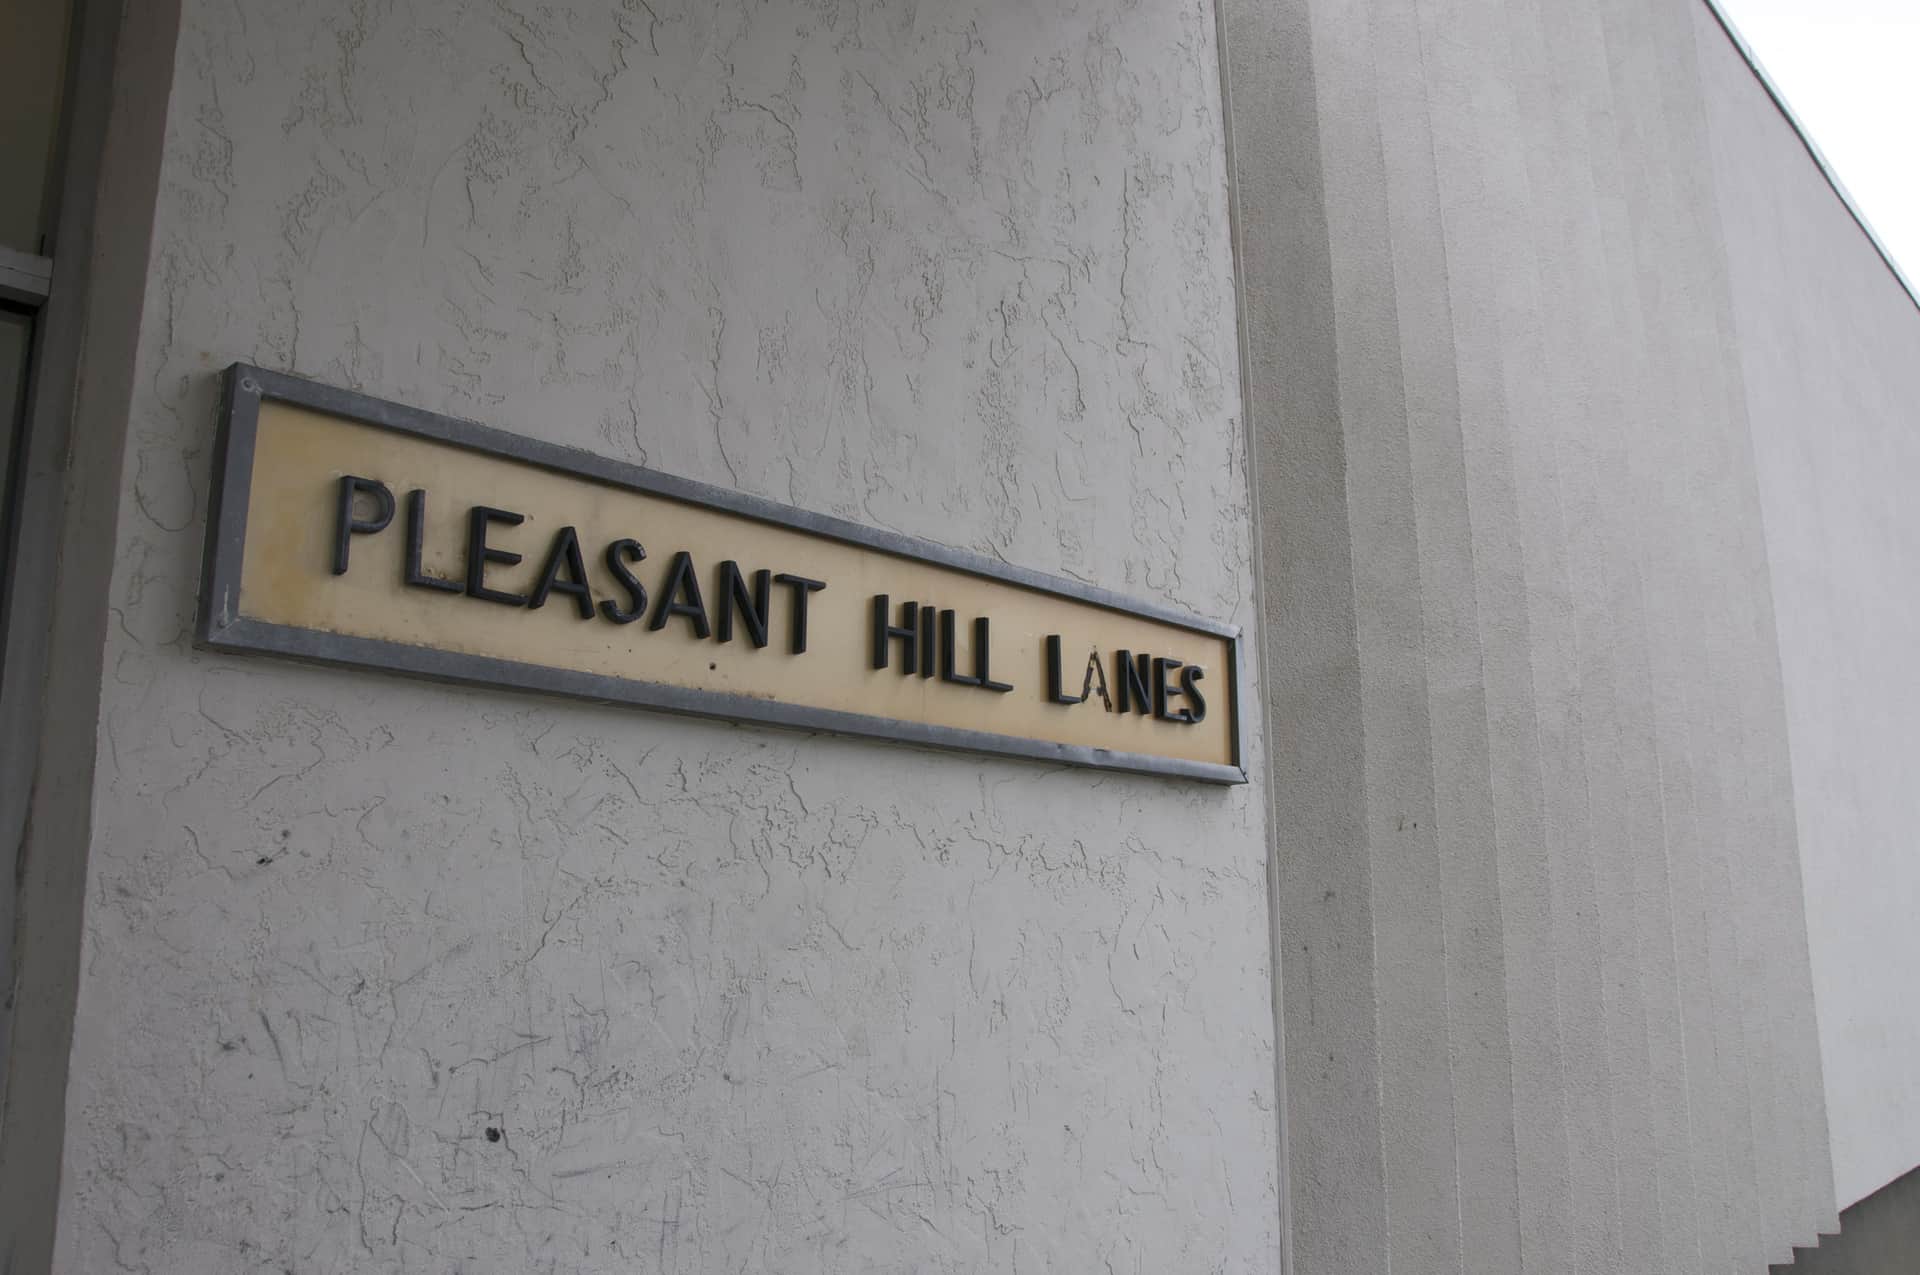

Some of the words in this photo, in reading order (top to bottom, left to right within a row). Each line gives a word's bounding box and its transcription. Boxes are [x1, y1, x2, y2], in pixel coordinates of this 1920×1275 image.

[331, 475, 827, 655] PLEASANT
[873, 594, 1014, 692] HILL
[1047, 634, 1207, 724] LANES
